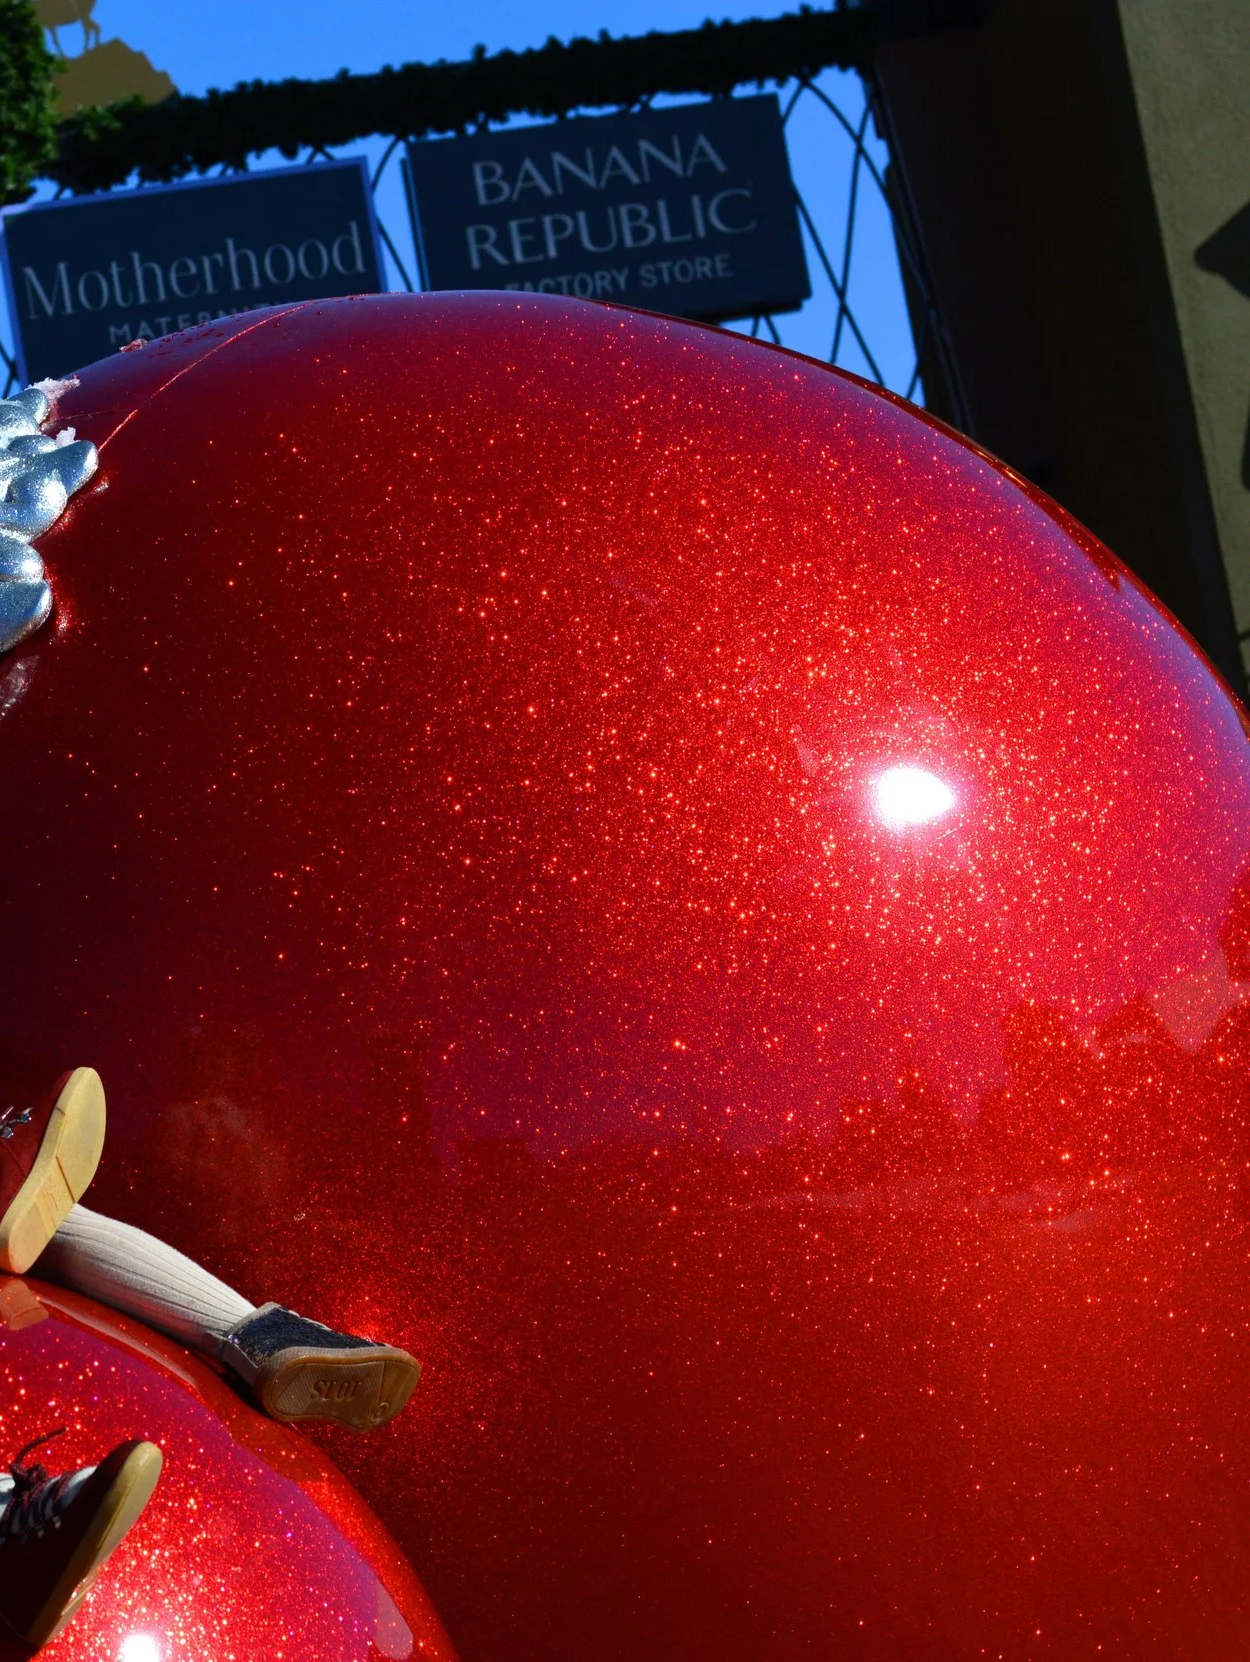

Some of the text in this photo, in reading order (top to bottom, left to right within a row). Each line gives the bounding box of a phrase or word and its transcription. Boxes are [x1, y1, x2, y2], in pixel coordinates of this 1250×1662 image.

[472, 132, 729, 207] BANANA
[465, 188, 758, 270] REPUBLIC
[22, 220, 368, 321] Motherhood
[639, 253, 734, 289] STORE
[108, 302, 290, 346] MATER
